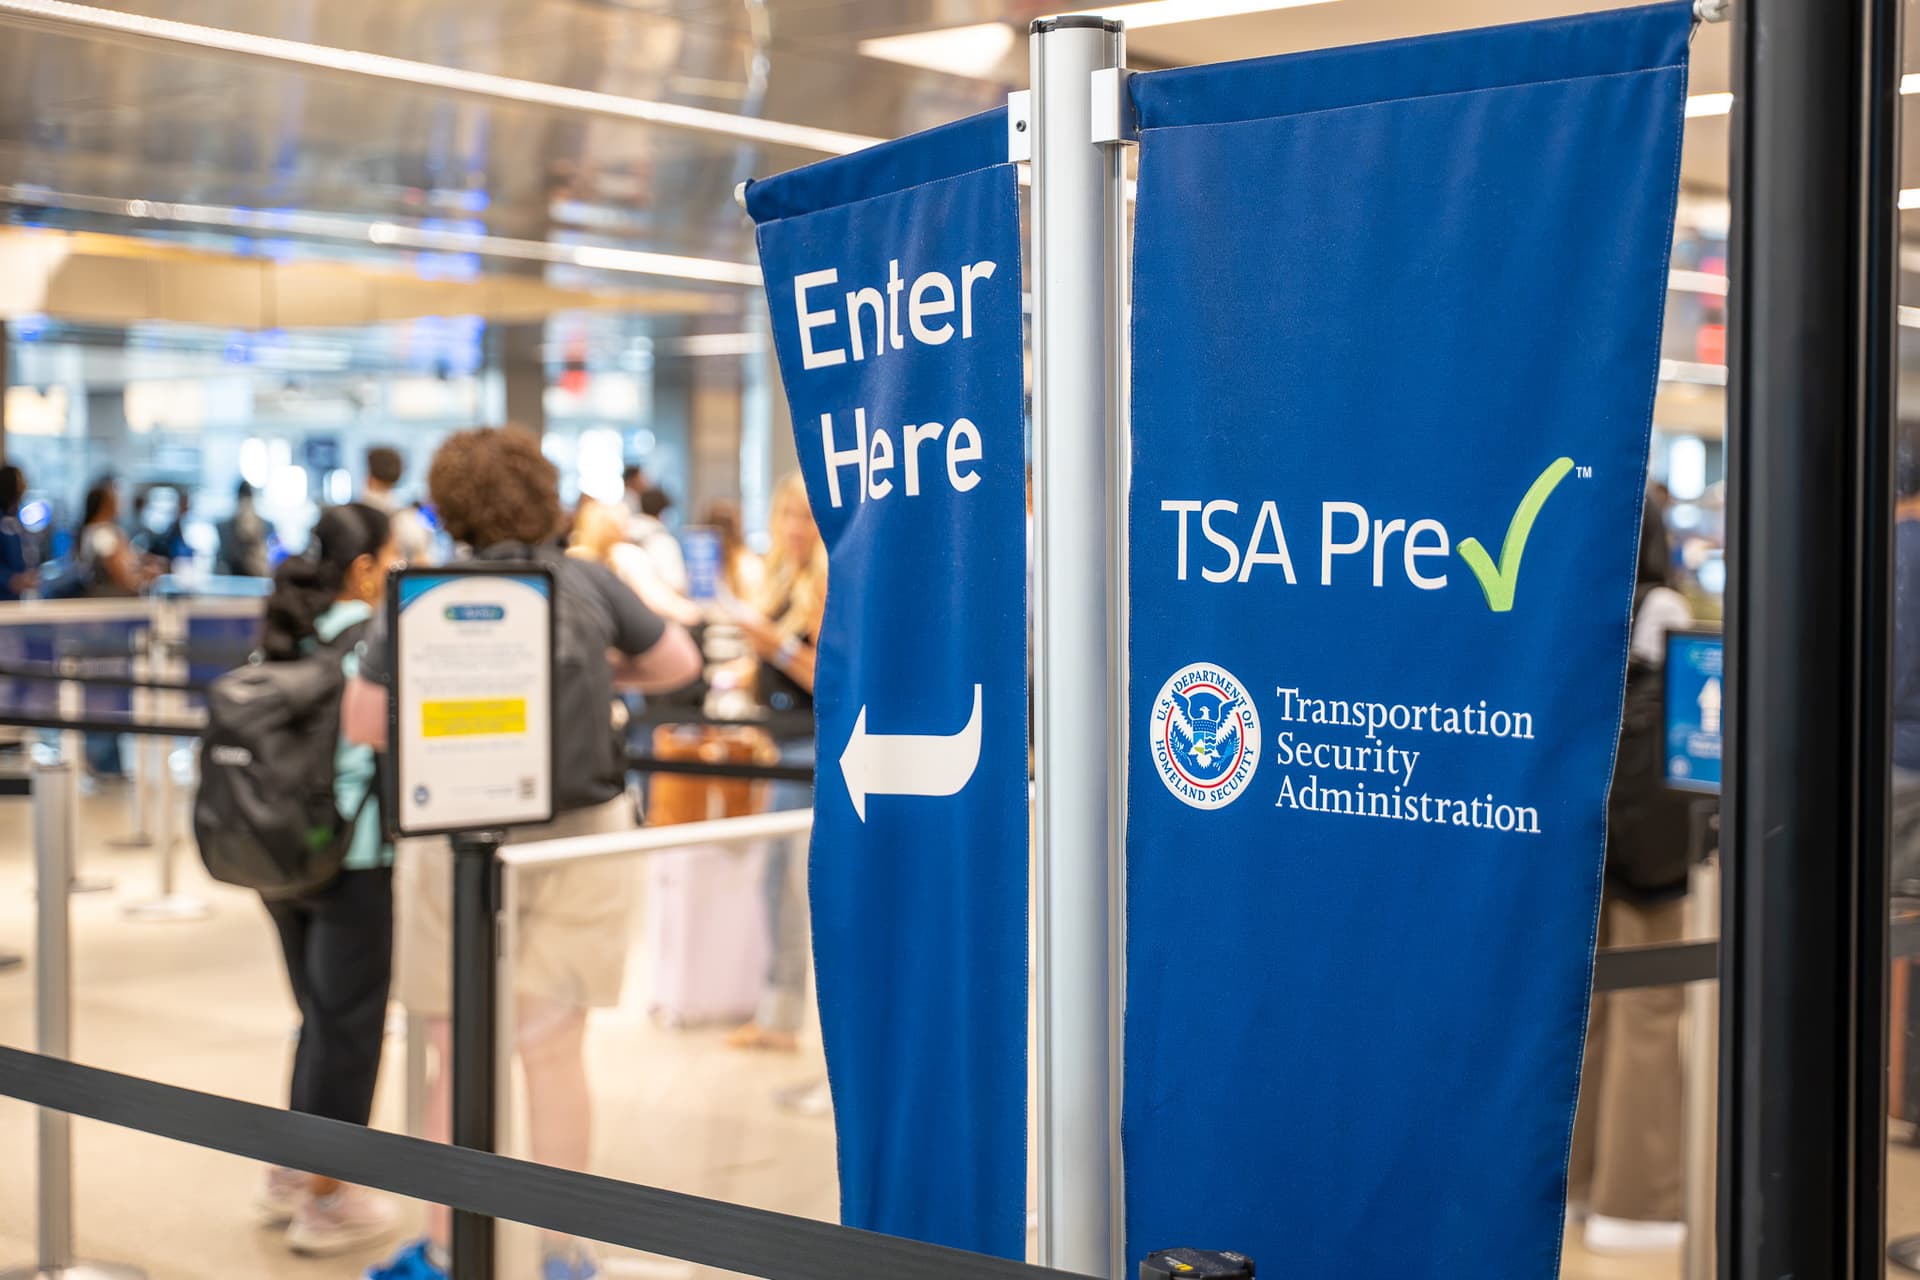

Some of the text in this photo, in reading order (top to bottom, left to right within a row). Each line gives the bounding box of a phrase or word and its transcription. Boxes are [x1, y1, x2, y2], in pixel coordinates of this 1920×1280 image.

[794, 258, 997, 370] Enter
[820, 407, 983, 508] Here
[1161, 499, 1297, 584] TSA
[1321, 501, 1450, 590] Pre
[1174, 671, 1247, 708] DEPARTMENT
[1242, 710, 1255, 730] OF
[1276, 686, 1535, 739] Transportation
[1155, 740, 1255, 802] HOMELAND SECURITY
[1277, 731, 1420, 787] Security
[1275, 774, 1541, 834] Administration
